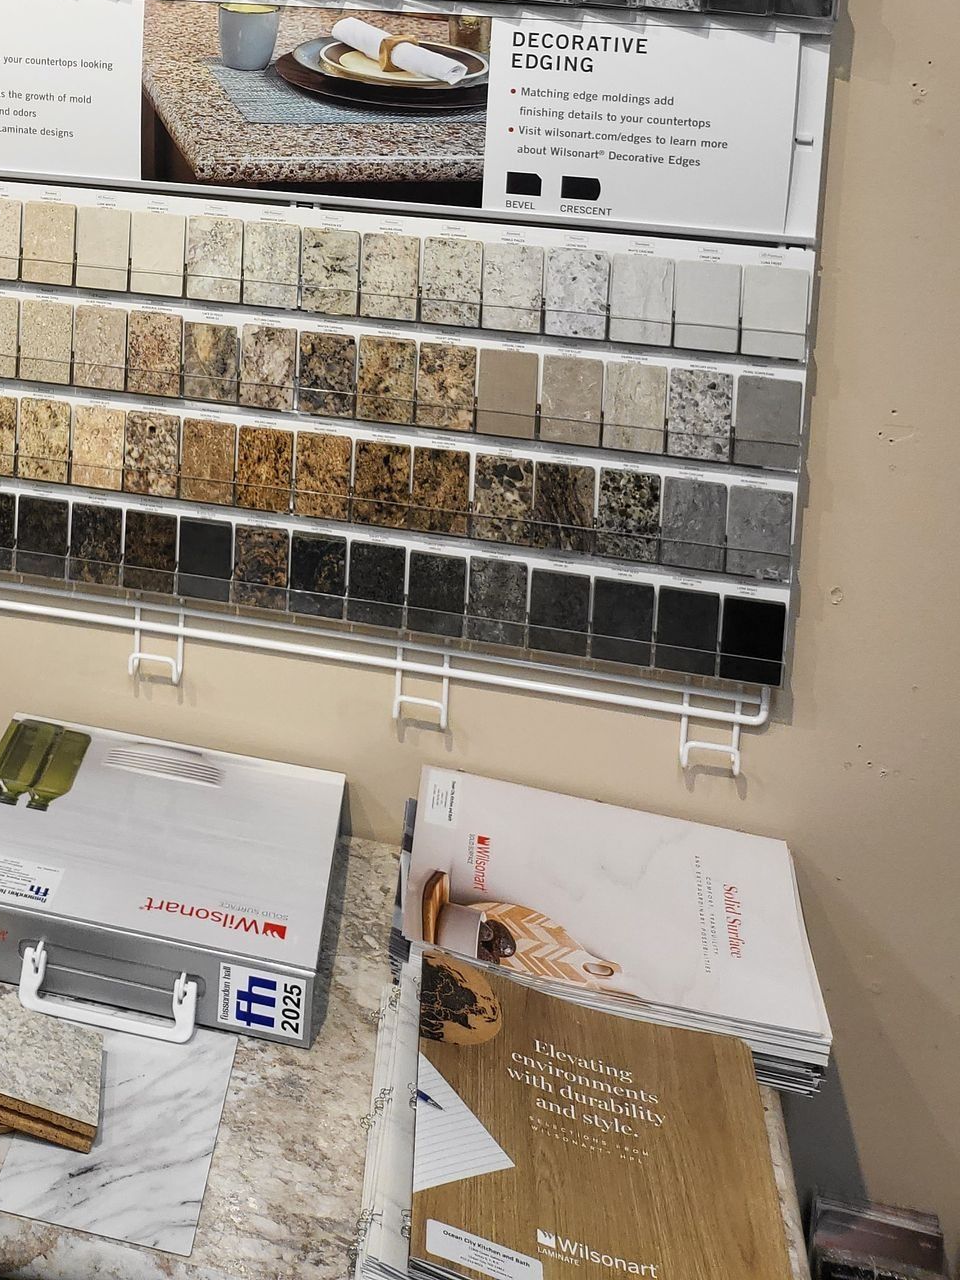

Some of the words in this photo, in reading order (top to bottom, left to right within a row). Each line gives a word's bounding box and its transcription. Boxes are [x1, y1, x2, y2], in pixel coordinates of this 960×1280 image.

[513, 31, 648, 54] DECORATIVE
[3, 56, 23, 66] your
[25, 56, 78, 68] countertops
[80, 58, 113, 71] looking
[511, 53, 594, 73] EDGING
[8, 89, 22, 100] the
[25, 91, 55, 102] growth
[57, 93, 67, 103] of
[69, 93, 92, 104] mold
[521, 87, 570, 101] Matching
[573, 90, 598, 102] edge
[601, 91, 650, 106] moldings
[653, 94, 674, 106] add
[13, 107, 37, 118] odors
[519, 106, 565, 121] finishing
[568, 108, 603, 122] details
[606, 111, 617, 122] to
[620, 114, 644, 125] your
[646, 114, 711, 129] countertops
[40, 126, 74, 138] designs
[518, 125, 542, 138] Visit
[544, 128, 652, 145] wilsonart.com/edges
[655, 135, 666, 145] to
[669, 136, 697, 147] learn
[700, 139, 728, 149] more
[517, 144, 547, 156] about
[608, 150, 665, 164] Decorative
[668, 154, 701, 168] Edges
[506, 199, 535, 211] BEVEL
[560, 204, 612, 217] CRESCENT
[723, 884, 742, 915] Solid
[262, 910, 289, 921] SOLID
[726, 916, 745, 959] Surface
[235, 976, 277, 1028] fh
[281, 983, 302, 1034] 2025
[534, 1039, 633, 1083] Elevating
[512, 1052, 659, 1104] environments
[507, 1067, 553, 1093] with
[560, 1086, 666, 1127] durability
[536, 1098, 576, 1120] and
[583, 1114, 639, 1137] style.
[442, 1229, 463, 1241] Ocean
[464, 1236, 477, 1247] City
[477, 1242, 501, 1257] Kitchen
[502, 1253, 514, 1261] and
[515, 1257, 530, 1267] Bath
[537, 1246, 580, 1266] LAMINATE
